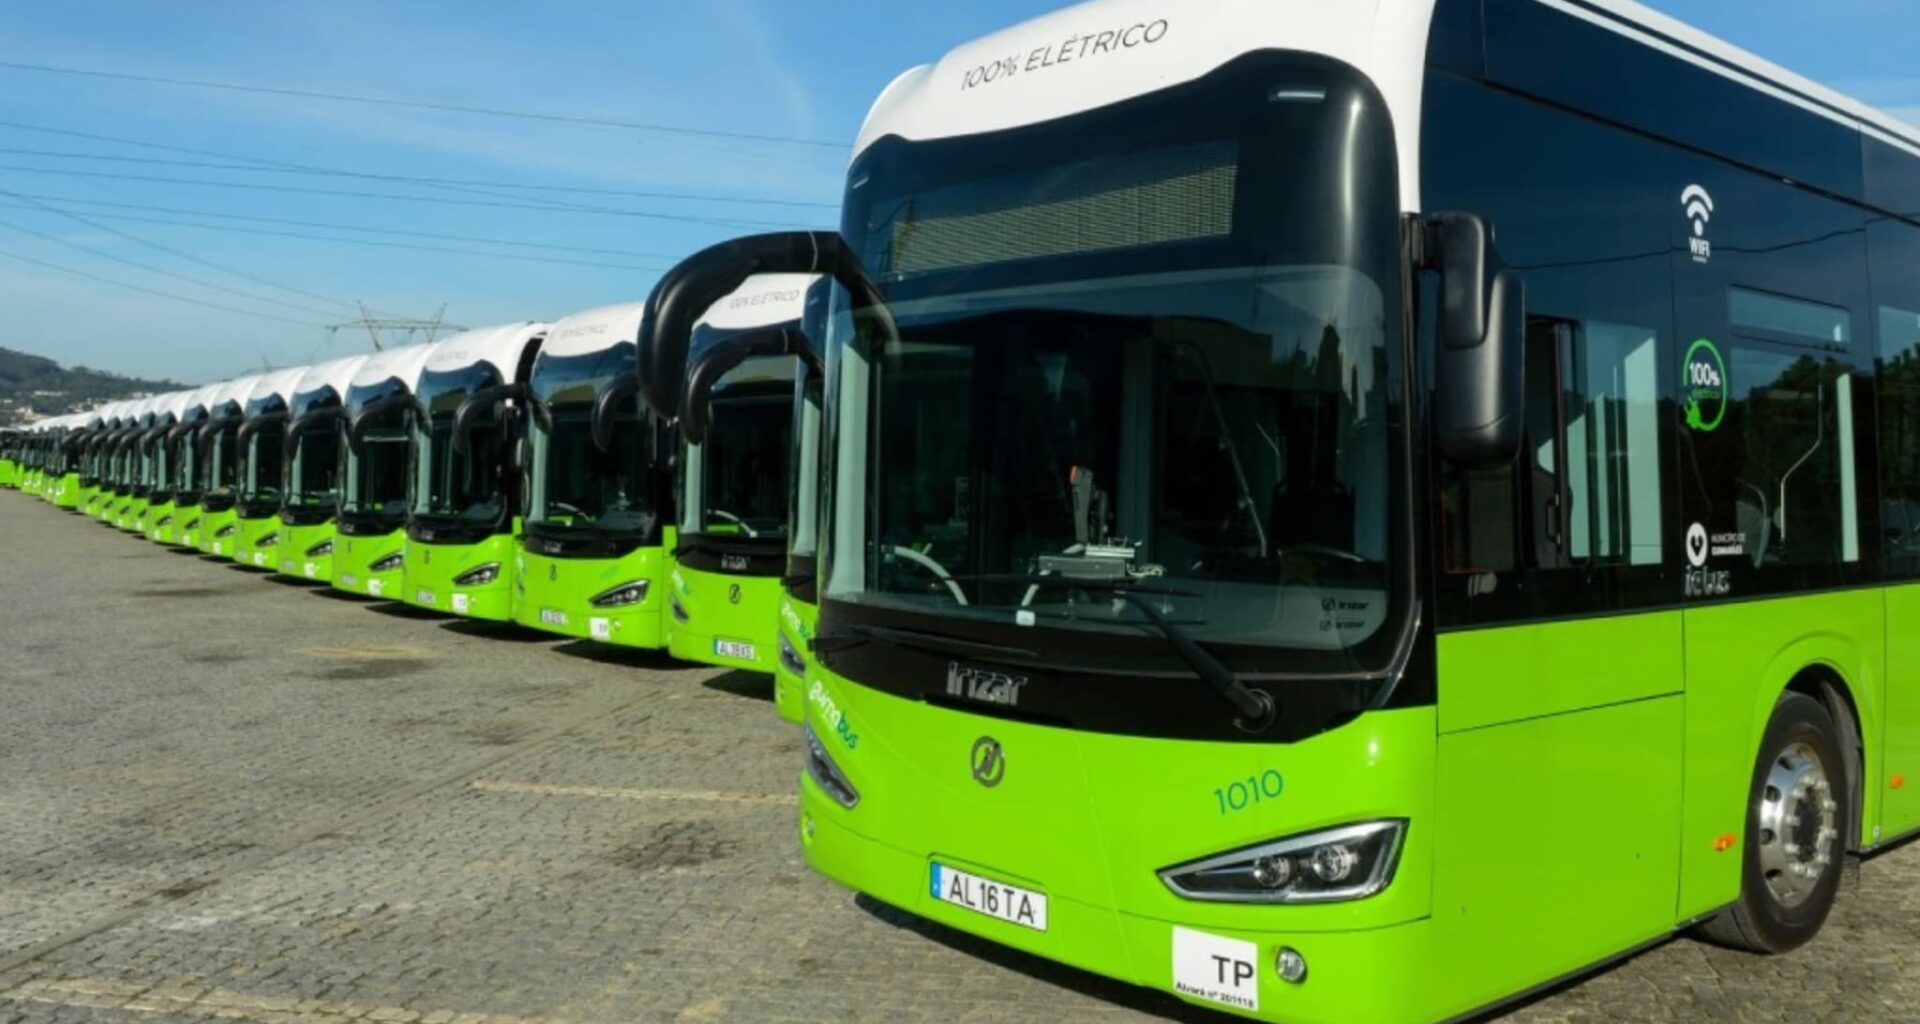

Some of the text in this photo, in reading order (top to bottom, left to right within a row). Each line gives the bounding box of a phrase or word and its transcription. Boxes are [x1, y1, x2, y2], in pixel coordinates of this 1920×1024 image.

[961, 19, 1169, 91] 100% ELÉTRICO
[1689, 362, 1720, 386] 100%
[1213, 768, 1284, 816] 1010
[949, 873, 1035, 925] AL 16 TA
[1211, 954, 1254, 987] TP
